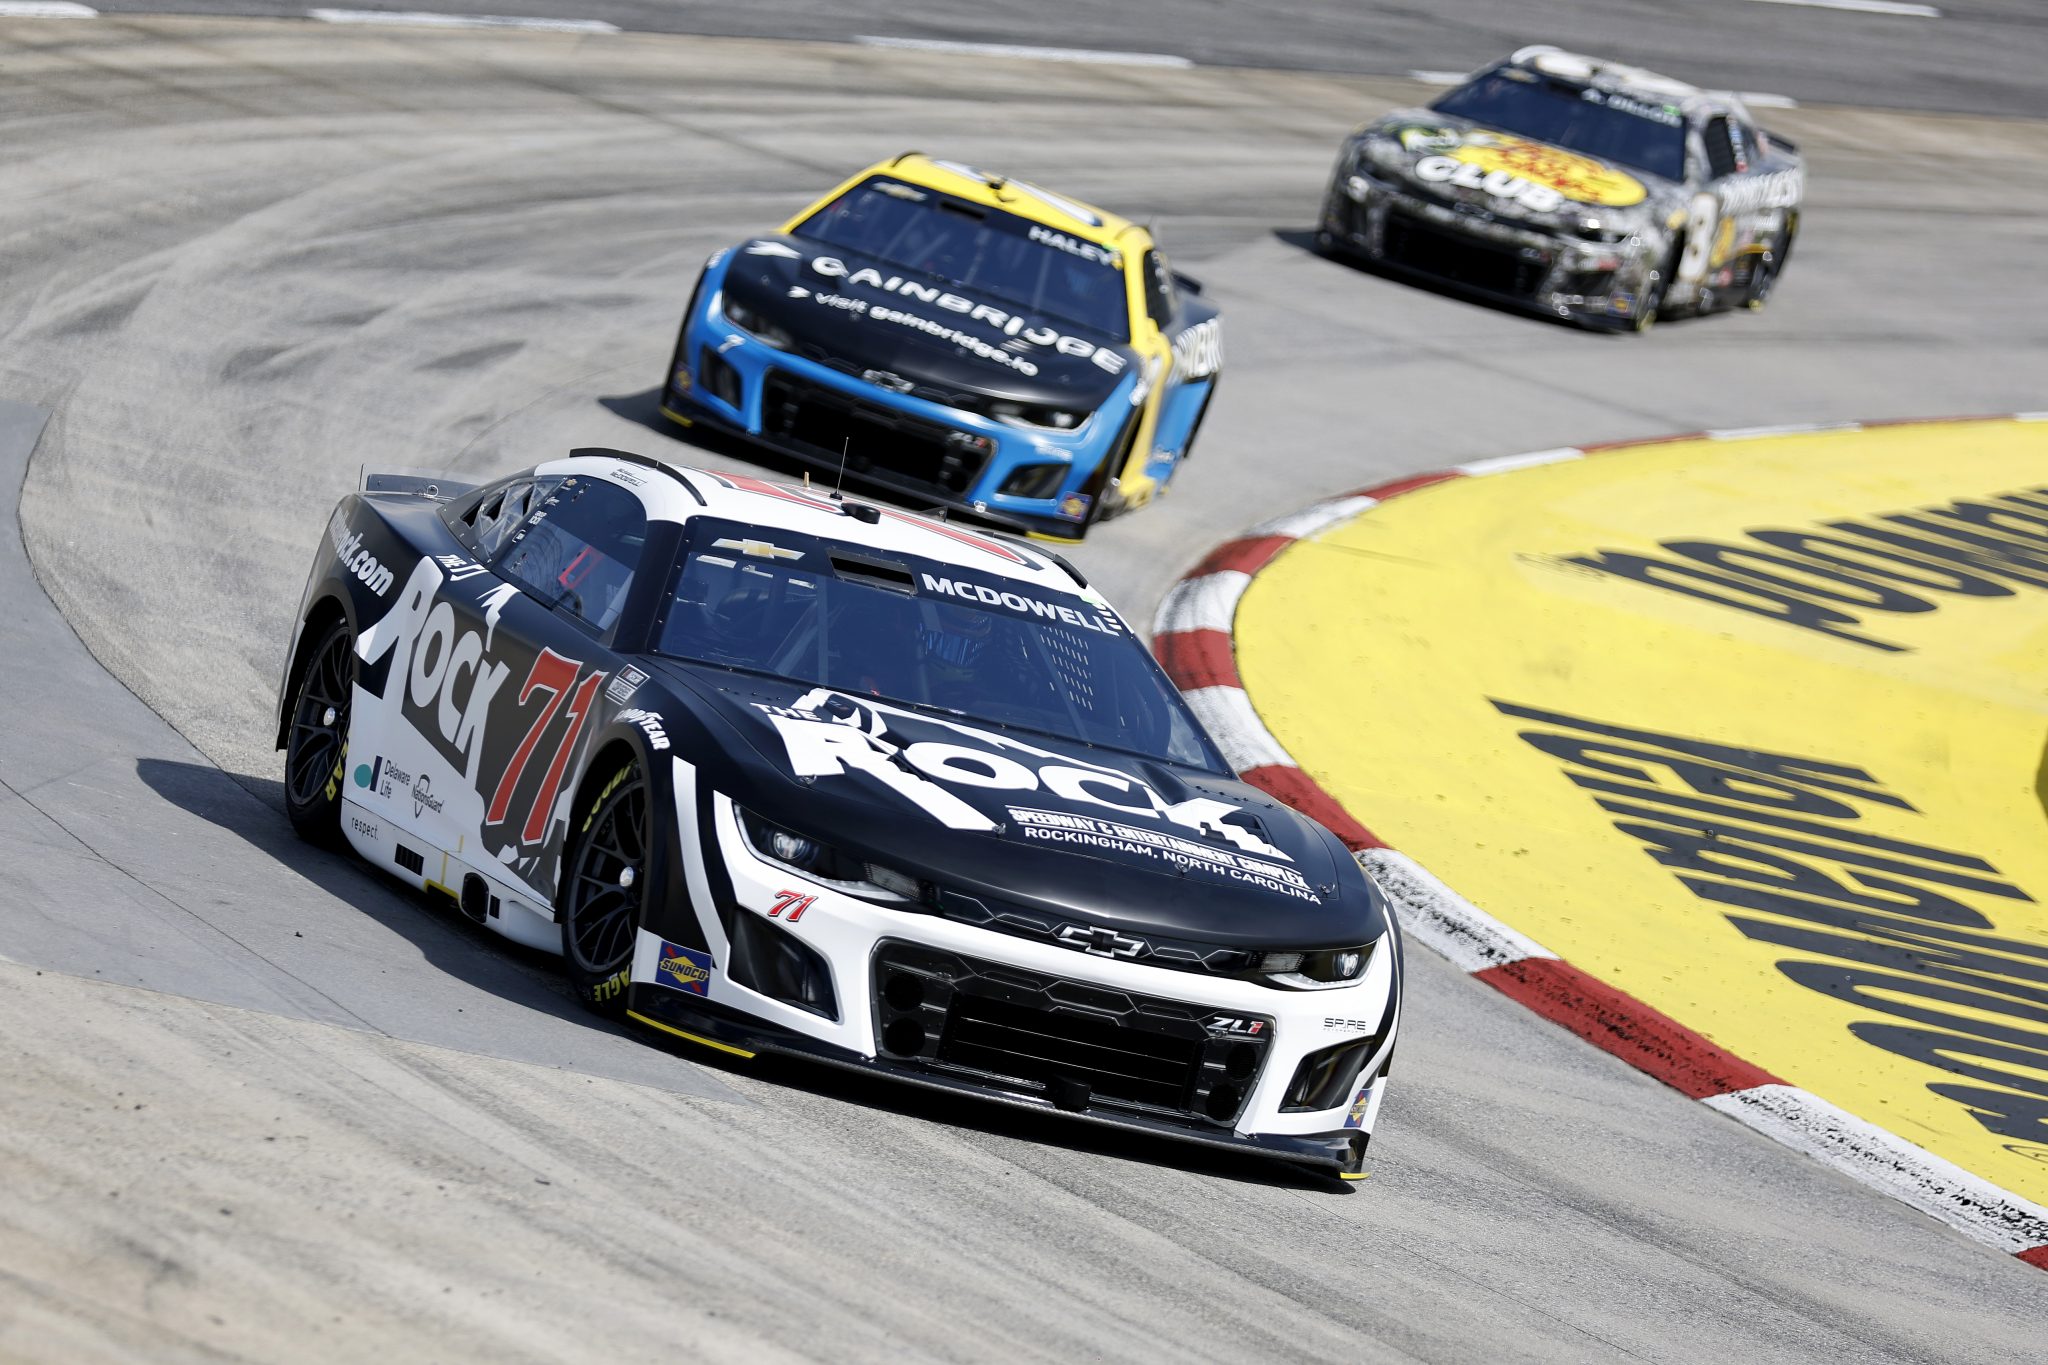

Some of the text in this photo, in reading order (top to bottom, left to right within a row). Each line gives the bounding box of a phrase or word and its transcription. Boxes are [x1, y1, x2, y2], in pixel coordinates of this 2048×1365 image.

[1415, 155, 1566, 212] CLUB
[811, 256, 1127, 375] GAINBRIDGE
[815, 292, 1039, 377] visit gainbridge.io
[922, 573, 1120, 637] MCDOWELL
[355, 555, 510, 775] ROCK
[384, 759, 411, 786] Delaware
[486, 646, 608, 846] 71
[380, 779, 392, 799] Life
[767, 714, 1295, 862] ROCK
[351, 817, 379, 841] respect.
[1008, 808, 1312, 890] SPEEDWAY & ENTERTAINMENT COMPLEX
[1024, 826, 1322, 906] ROCKINGHAM, NORTH CAROLINA
[767, 889, 818, 923] 71
[593, 965, 630, 1002] AGLE
[660, 958, 709, 983] SUNOCO
[1207, 1015, 1265, 1036] ZL1
